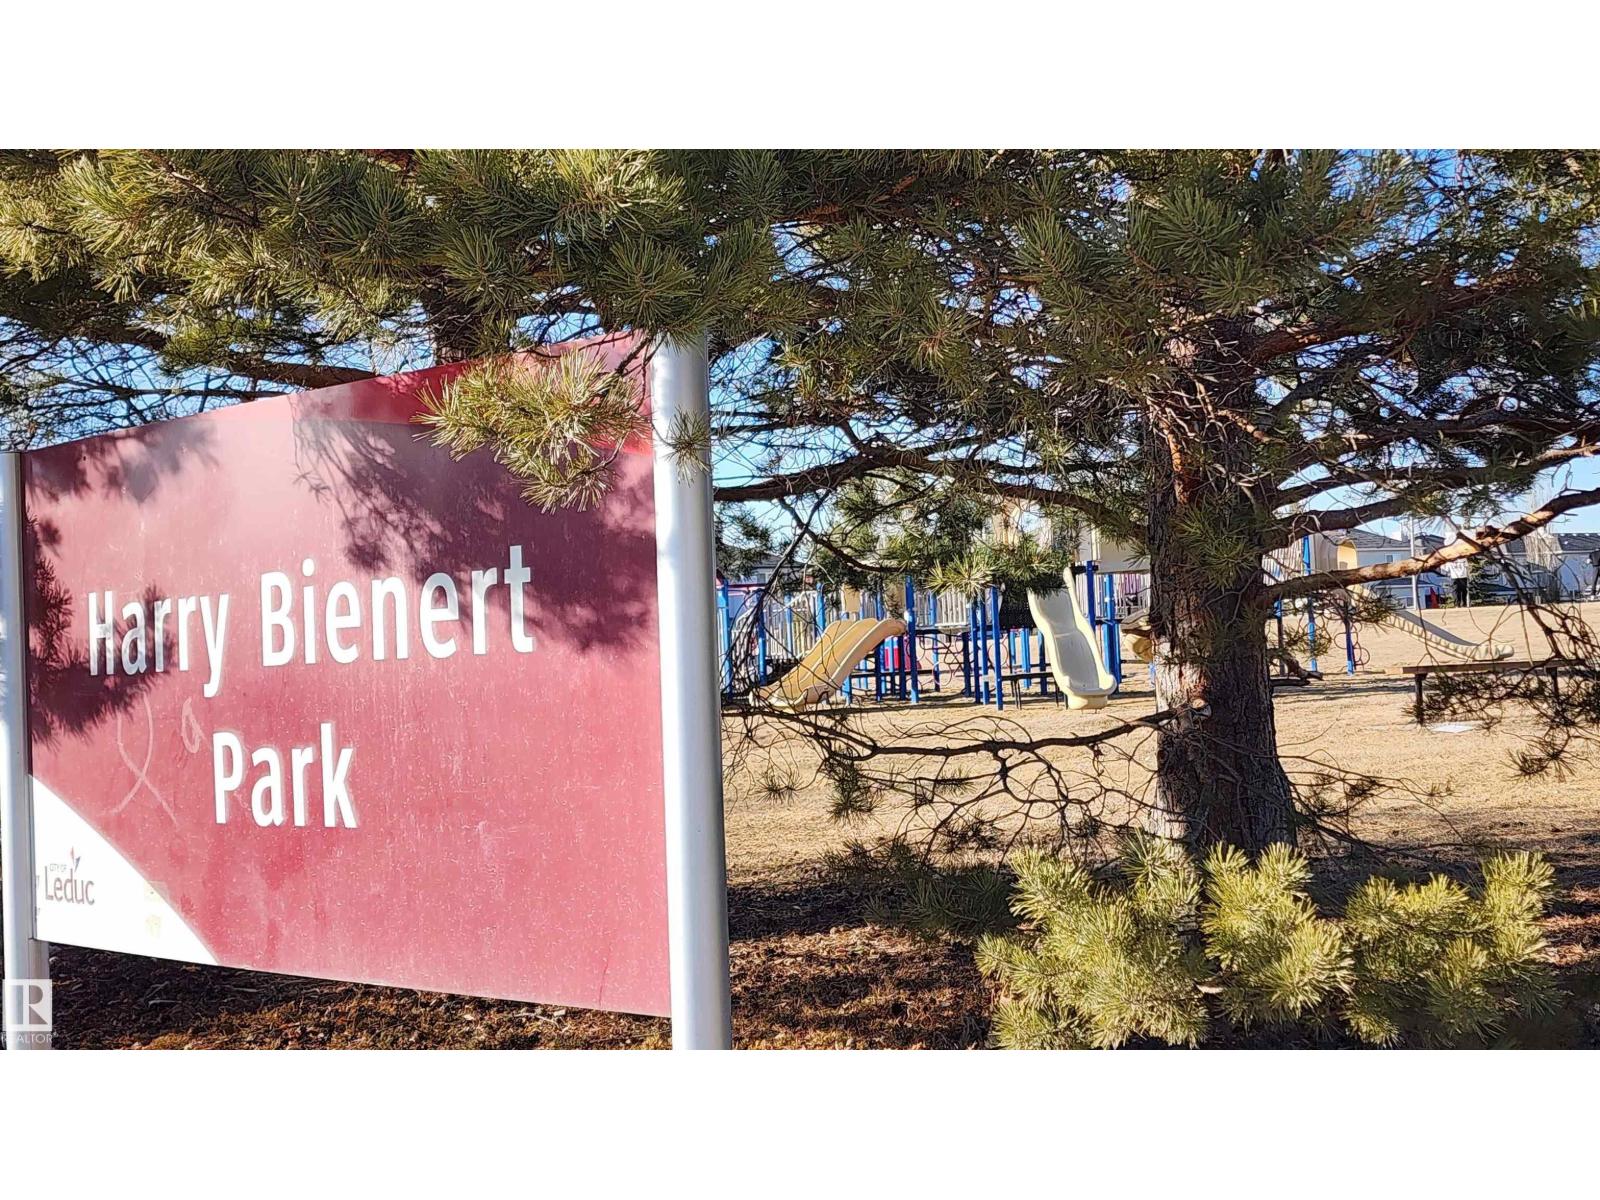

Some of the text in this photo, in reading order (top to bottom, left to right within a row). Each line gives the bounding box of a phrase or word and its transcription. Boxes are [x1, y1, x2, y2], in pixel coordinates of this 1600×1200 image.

[88, 545, 534, 697] Harry Bienert
[212, 722, 358, 829] Park
[44, 865, 95, 905] Leduc
